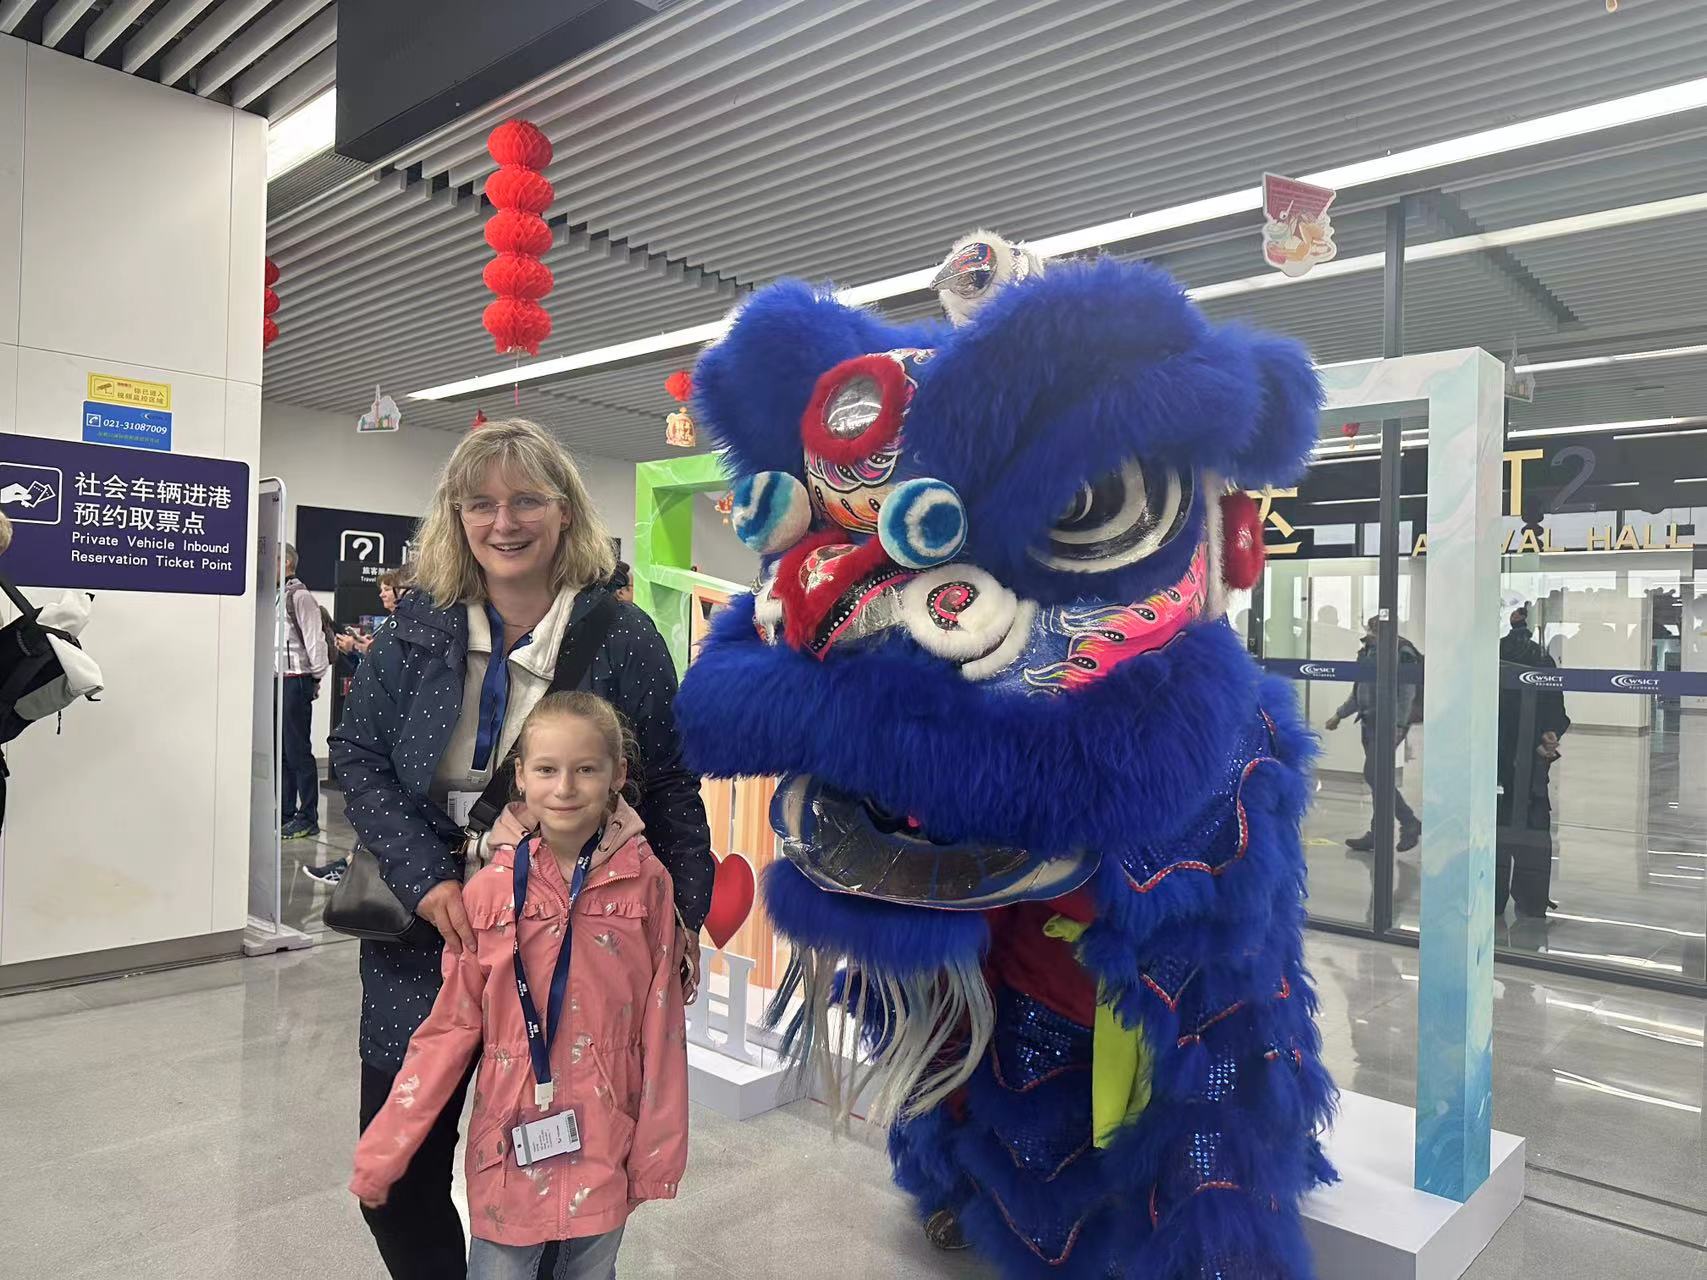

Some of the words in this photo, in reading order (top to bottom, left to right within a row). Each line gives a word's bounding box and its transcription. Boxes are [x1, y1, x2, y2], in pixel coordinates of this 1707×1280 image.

[103, 418, 168, 435] 021-31087009
[74, 471, 232, 510] 社会车辆进港
[73, 502, 206, 535] 预约取票点
[71, 531, 119, 546] Private
[127, 535, 175, 550] Vehicle
[183, 539, 230, 554] Inbound
[1586, 522, 1697, 551] HALL
[71, 550, 148, 566] Reservation
[155, 555, 195, 569] Ticket
[201, 558, 232, 571] Point
